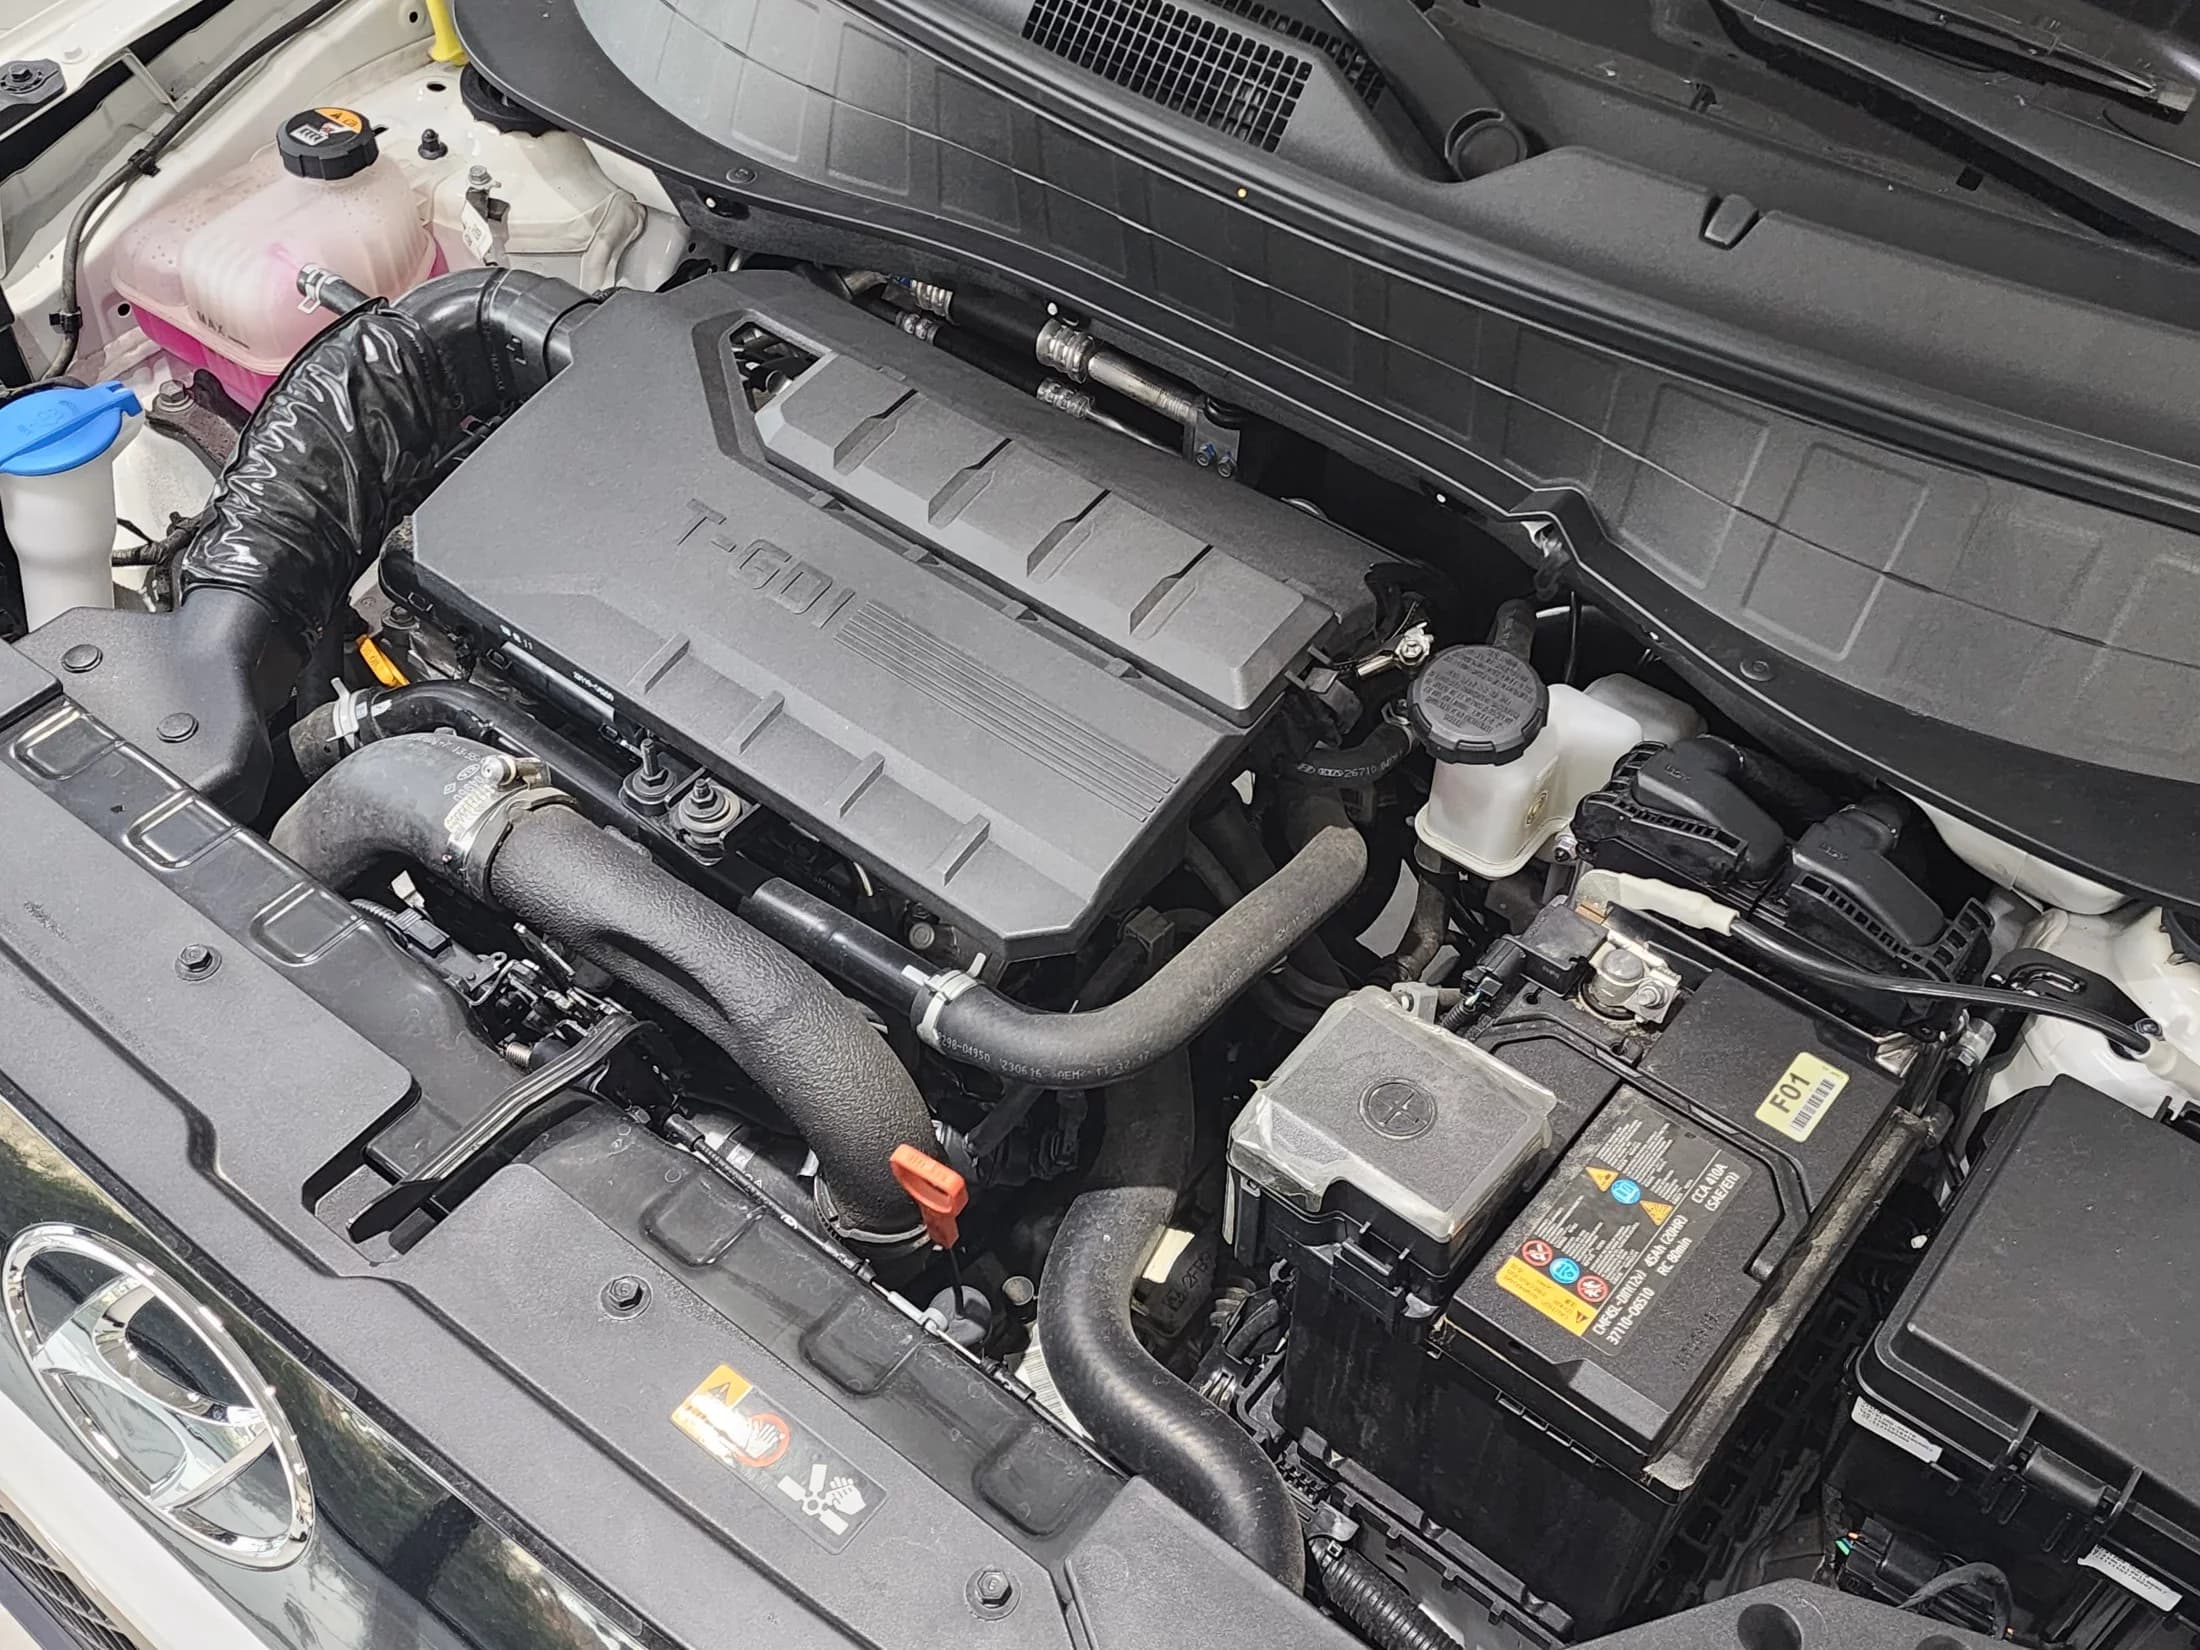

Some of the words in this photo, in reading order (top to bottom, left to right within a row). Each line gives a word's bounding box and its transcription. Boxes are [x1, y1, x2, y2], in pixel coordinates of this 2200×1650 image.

[676, 498, 856, 629] T-GDI
[1768, 1069, 1810, 1115] F01
[1642, 1241, 1666, 1268] 45Ah
[1659, 1212, 1688, 1246] (20HR)
[1692, 1183, 1711, 1205] CCA
[1705, 1161, 1728, 1187] 410A
[1657, 1258, 1674, 1277] RC
[1666, 1234, 1692, 1264] 80min
